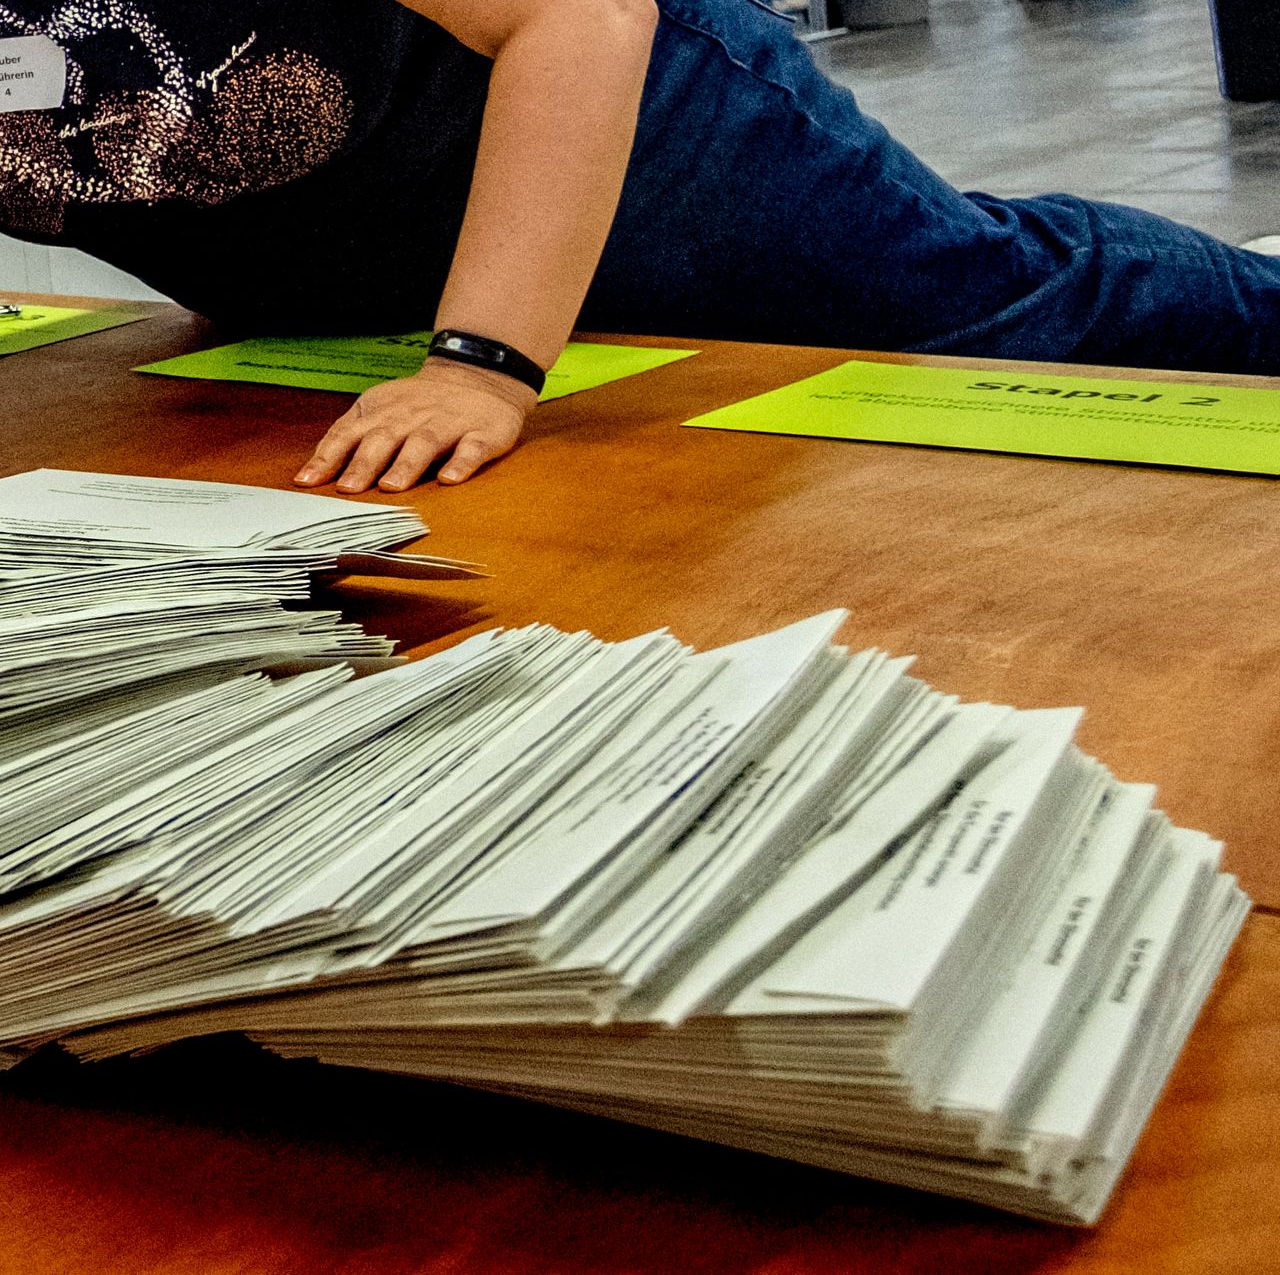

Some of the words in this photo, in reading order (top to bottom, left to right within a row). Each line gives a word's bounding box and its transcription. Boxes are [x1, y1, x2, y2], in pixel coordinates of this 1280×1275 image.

[5, 88, 11, 96] 4
[967, 382, 1163, 403] Stapel
[1179, 397, 1222, 407] 2
